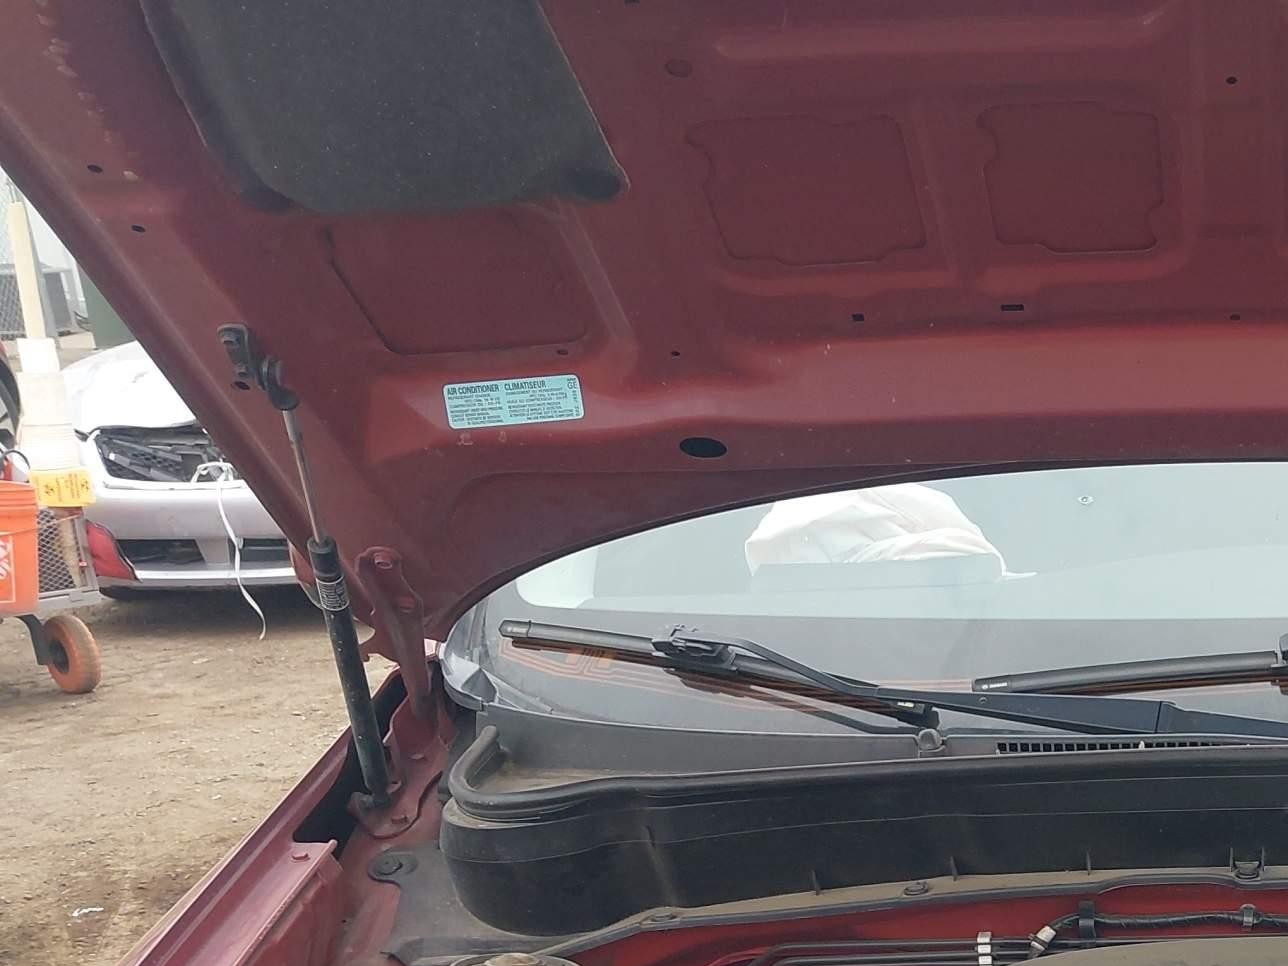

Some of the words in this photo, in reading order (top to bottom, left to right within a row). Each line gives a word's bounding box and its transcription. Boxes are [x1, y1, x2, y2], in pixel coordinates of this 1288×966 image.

[447, 387, 458, 395] AIR
[457, 383, 500, 395] CONDITIONER
[504, 380, 547, 391] CLIMATISEUR
